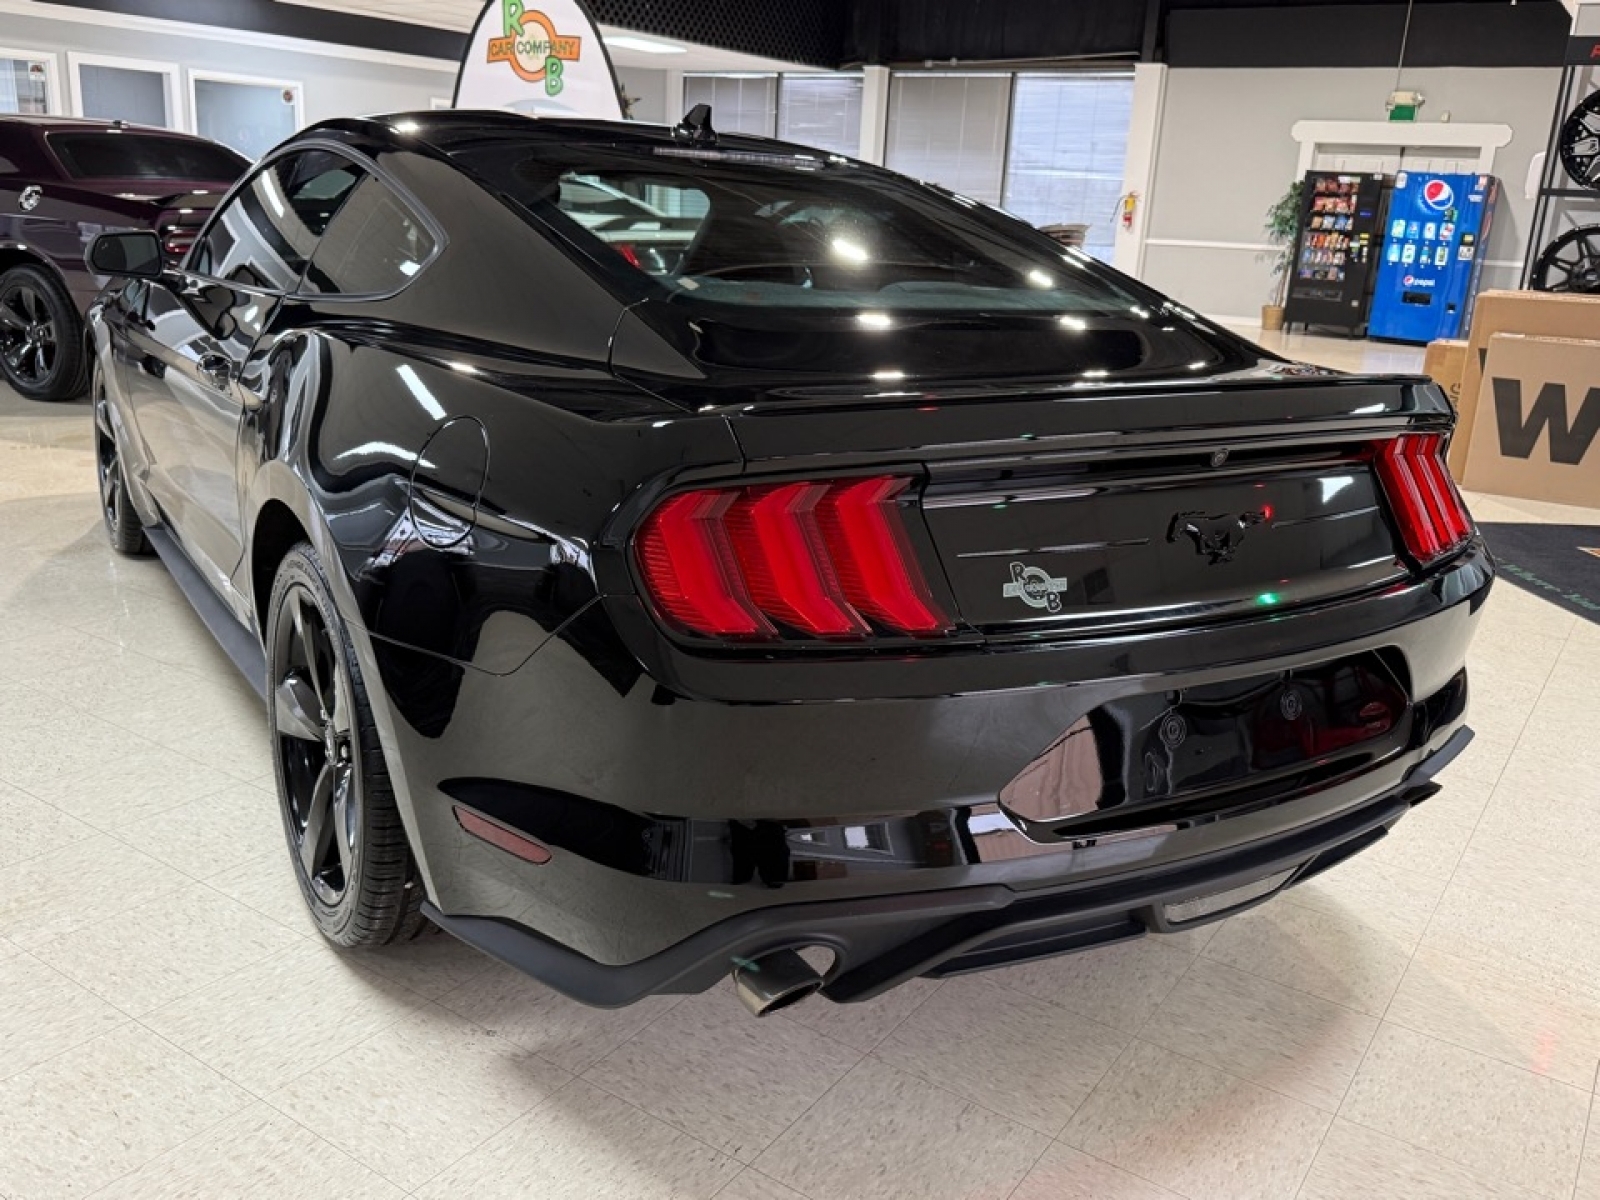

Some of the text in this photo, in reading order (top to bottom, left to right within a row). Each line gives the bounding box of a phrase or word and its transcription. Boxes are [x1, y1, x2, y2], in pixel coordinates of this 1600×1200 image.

[502, 0, 525, 37] R
[490, 40, 576, 56] CAR COMPANY
[544, 55, 564, 97] B
